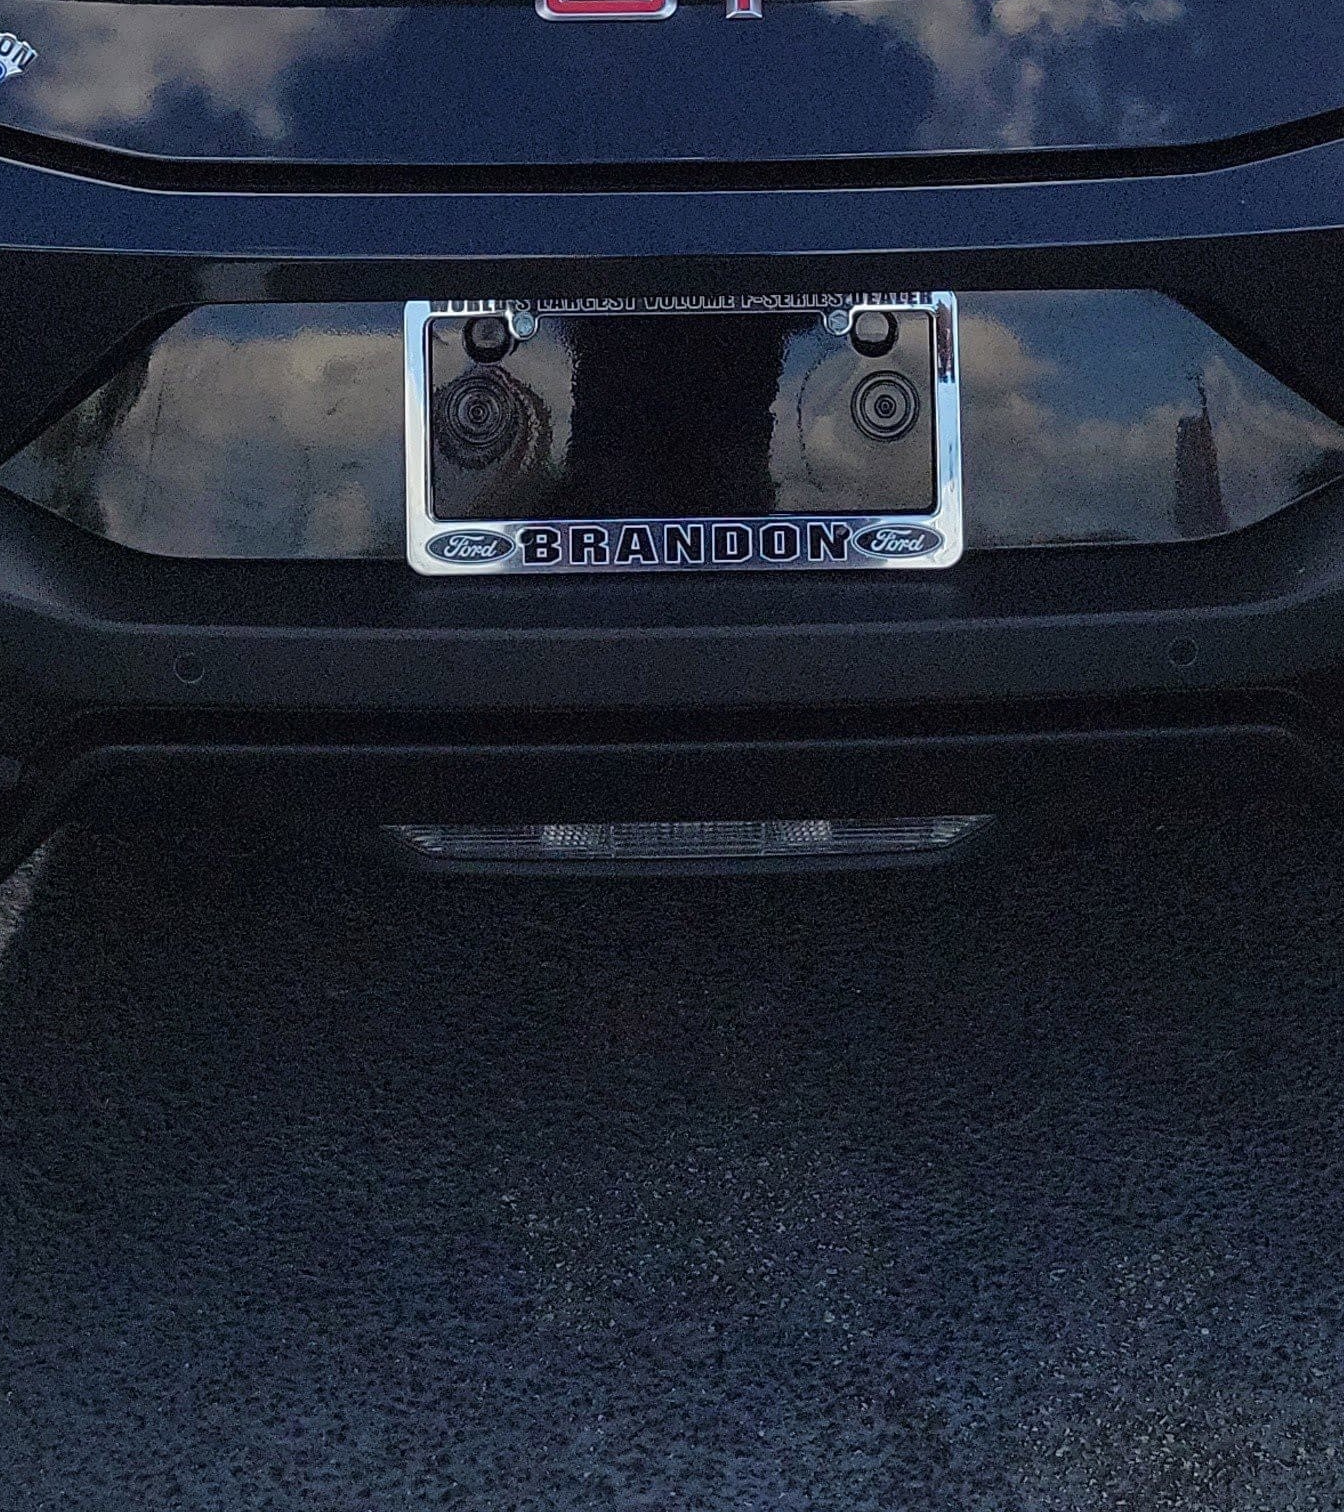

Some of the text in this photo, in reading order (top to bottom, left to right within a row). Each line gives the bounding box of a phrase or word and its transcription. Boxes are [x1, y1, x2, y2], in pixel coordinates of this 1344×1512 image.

[443, 535, 498, 558] Ford
[519, 522, 851, 566] BRANDON
[870, 528, 925, 553] Ford
